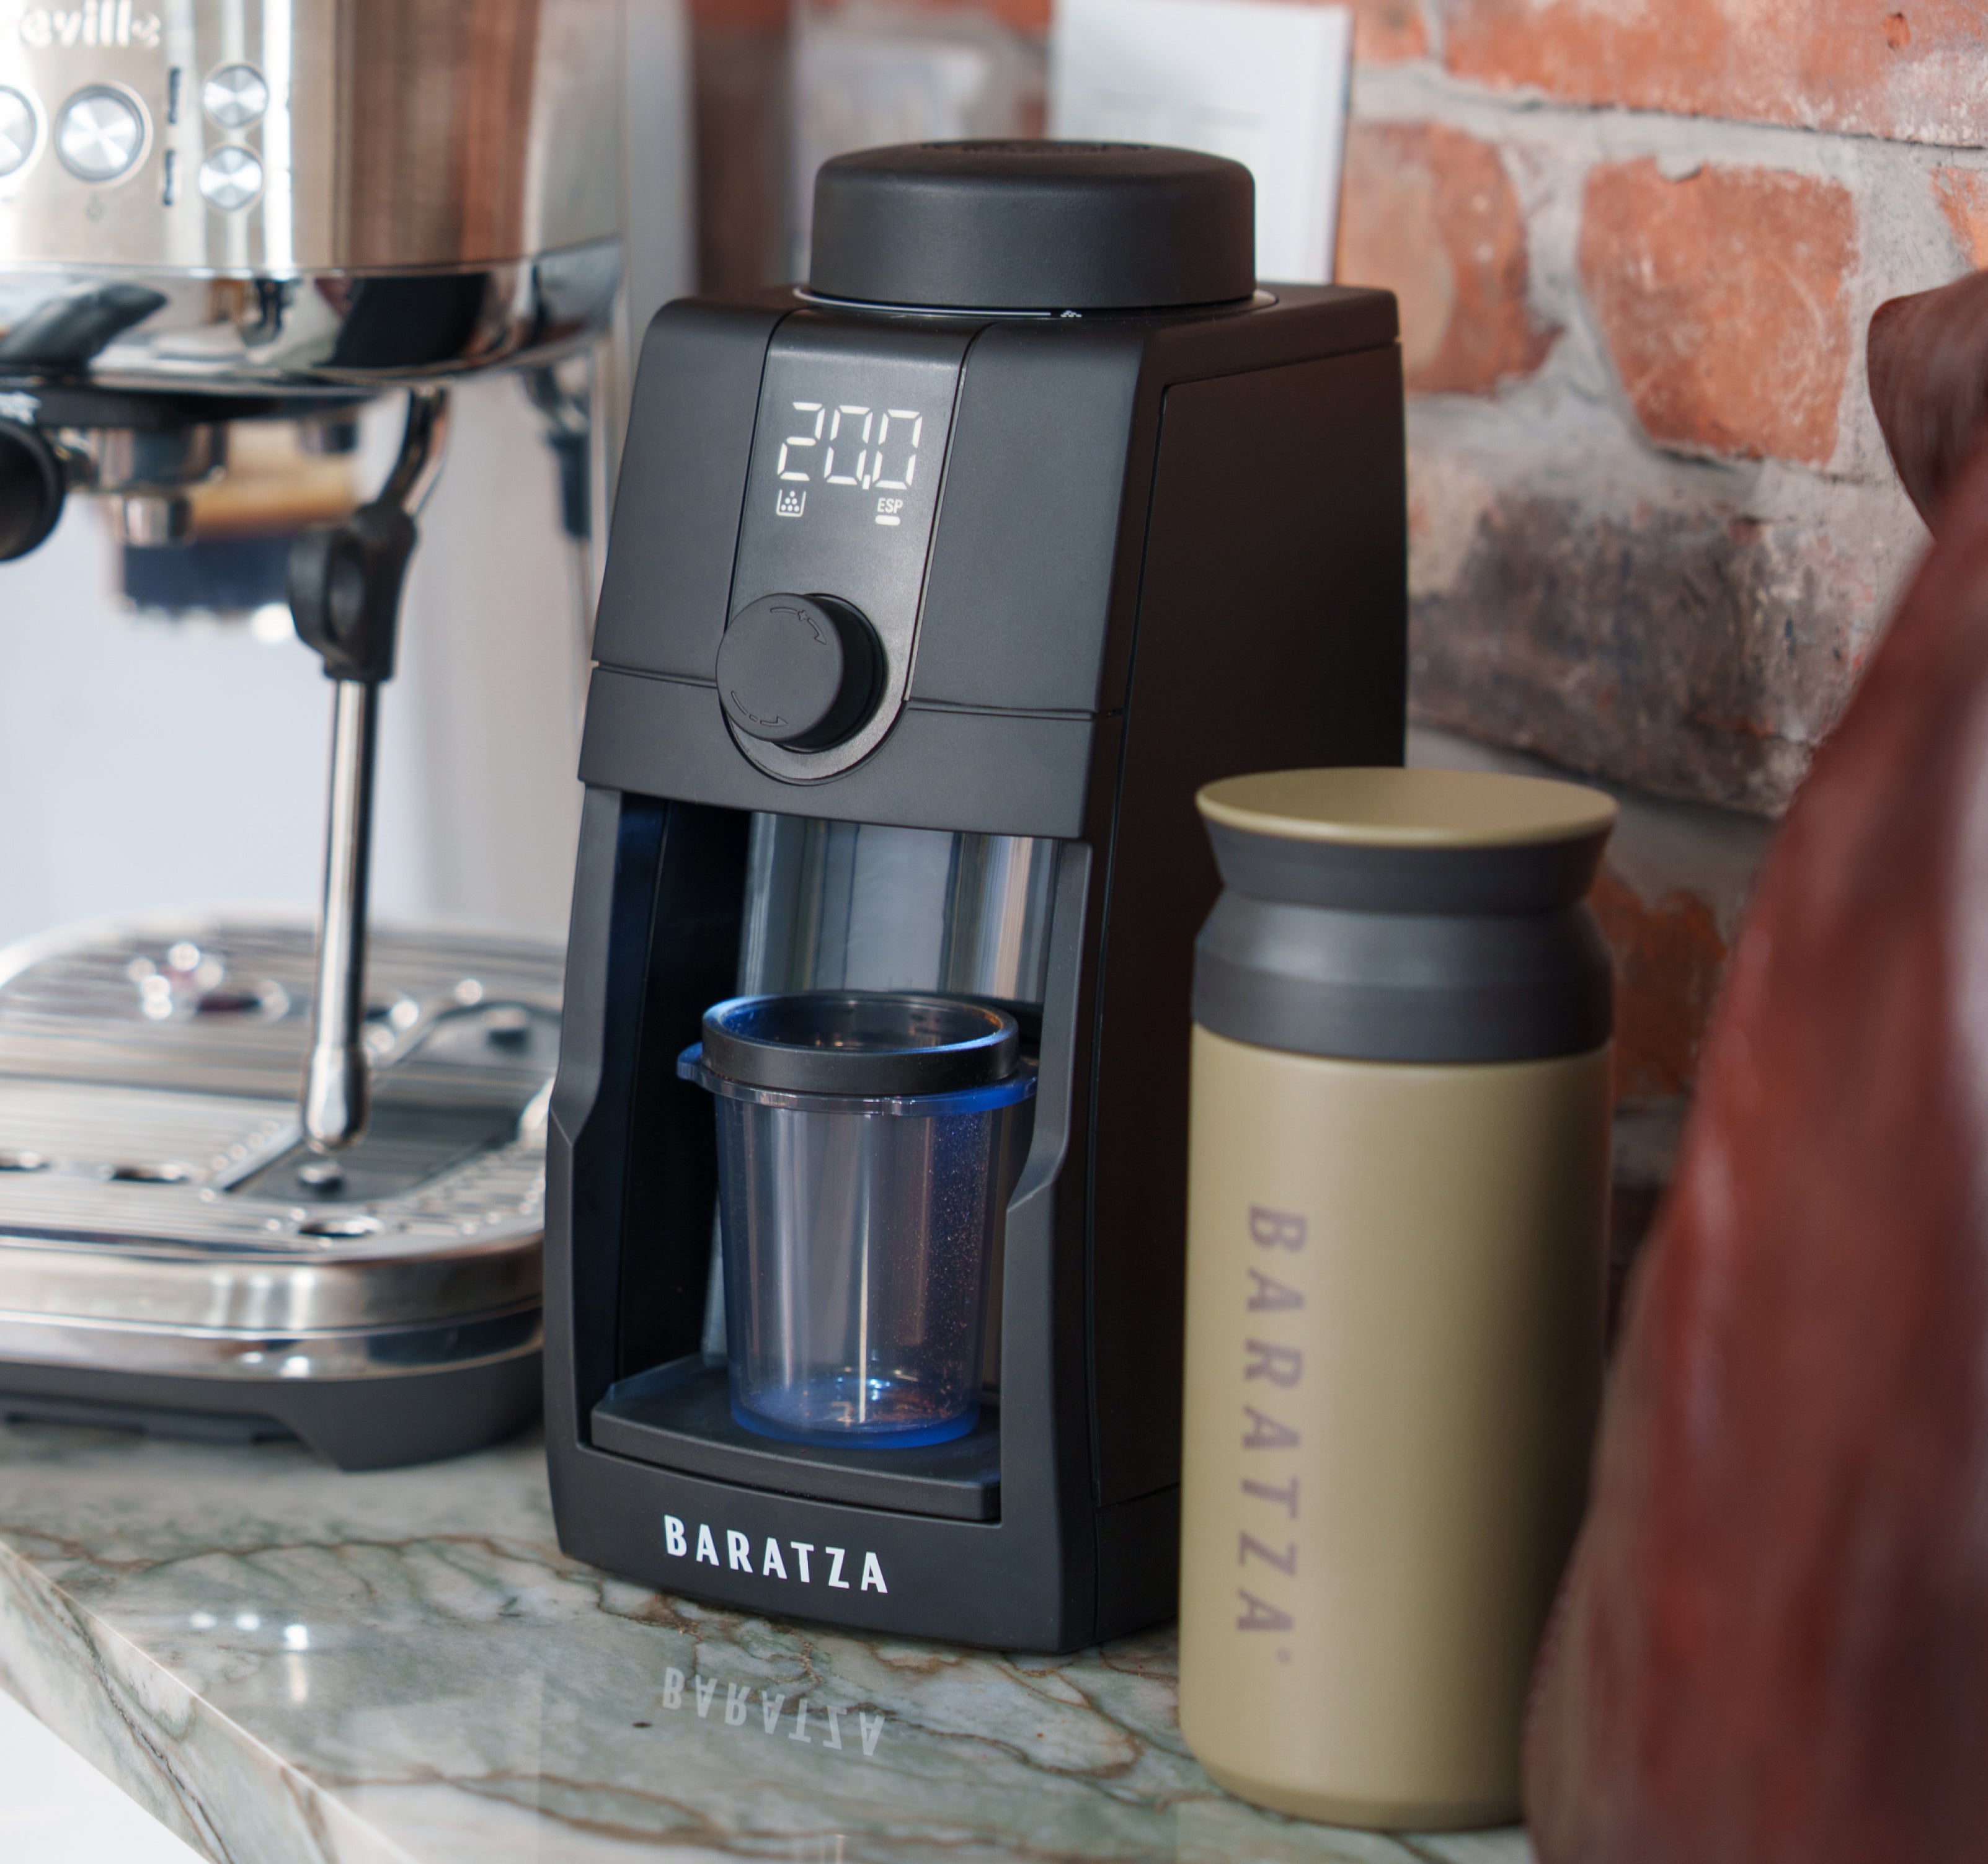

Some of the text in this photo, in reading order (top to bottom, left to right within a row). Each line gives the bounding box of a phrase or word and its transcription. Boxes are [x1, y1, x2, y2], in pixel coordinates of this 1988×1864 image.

[5, 0, 161, 48] eville
[877, 498, 903, 513] ESP
[663, 1514, 888, 1594] BARATZA
